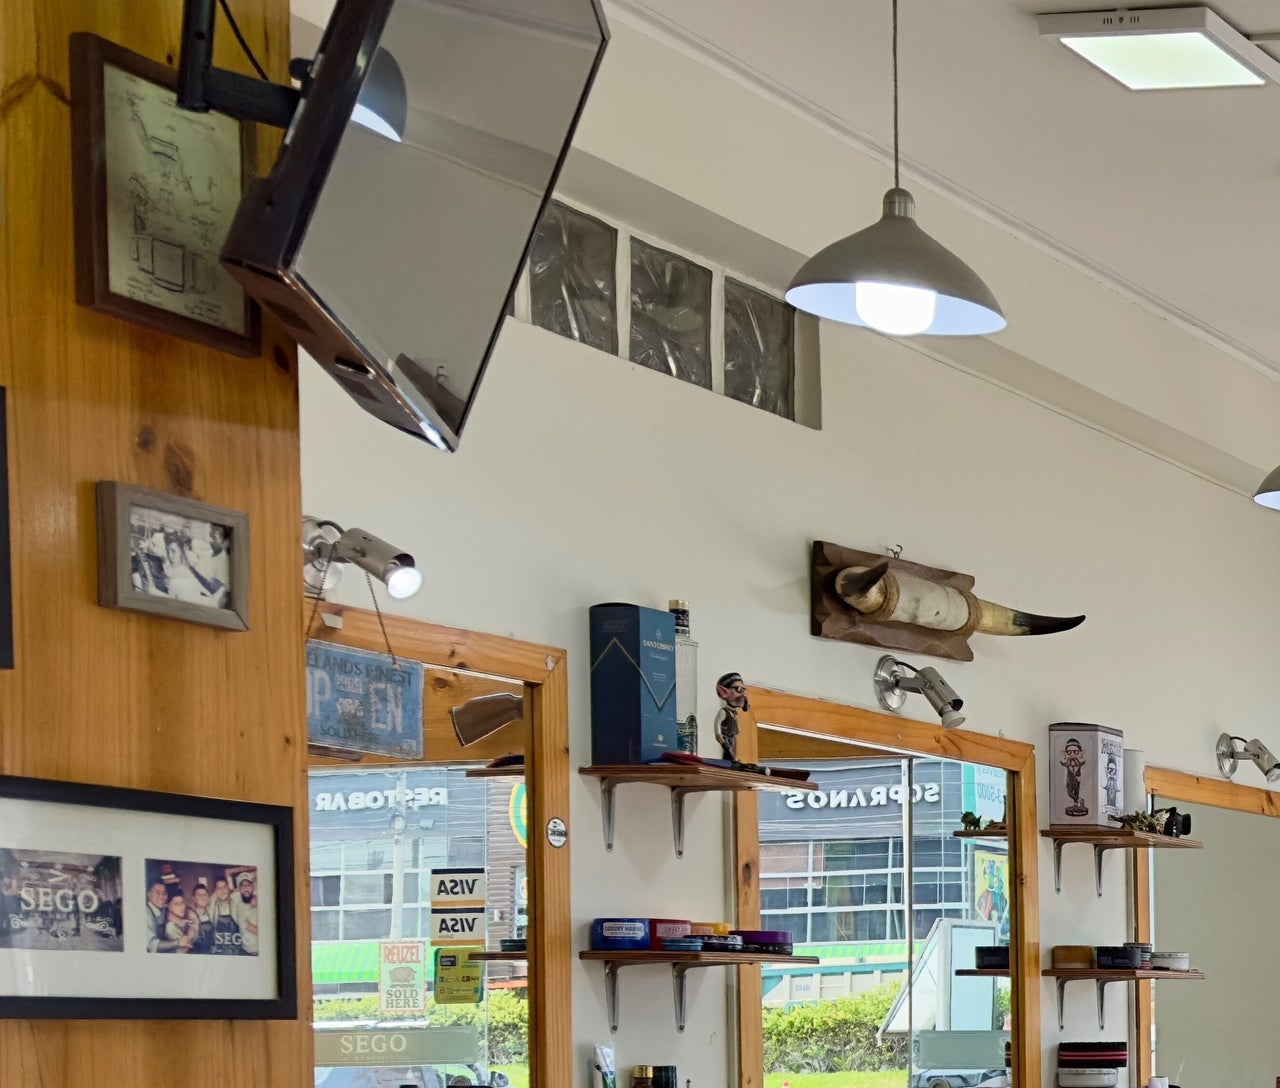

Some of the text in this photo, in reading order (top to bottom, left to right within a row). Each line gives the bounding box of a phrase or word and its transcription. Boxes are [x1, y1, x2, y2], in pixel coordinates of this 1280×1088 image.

[364, 662, 415, 689] FINEST
[20, 886, 99, 914] SEGO
[385, 989, 419, 999] SOLD
[385, 998, 420, 1009] HERE
[340, 1033, 408, 1053] SEGO
